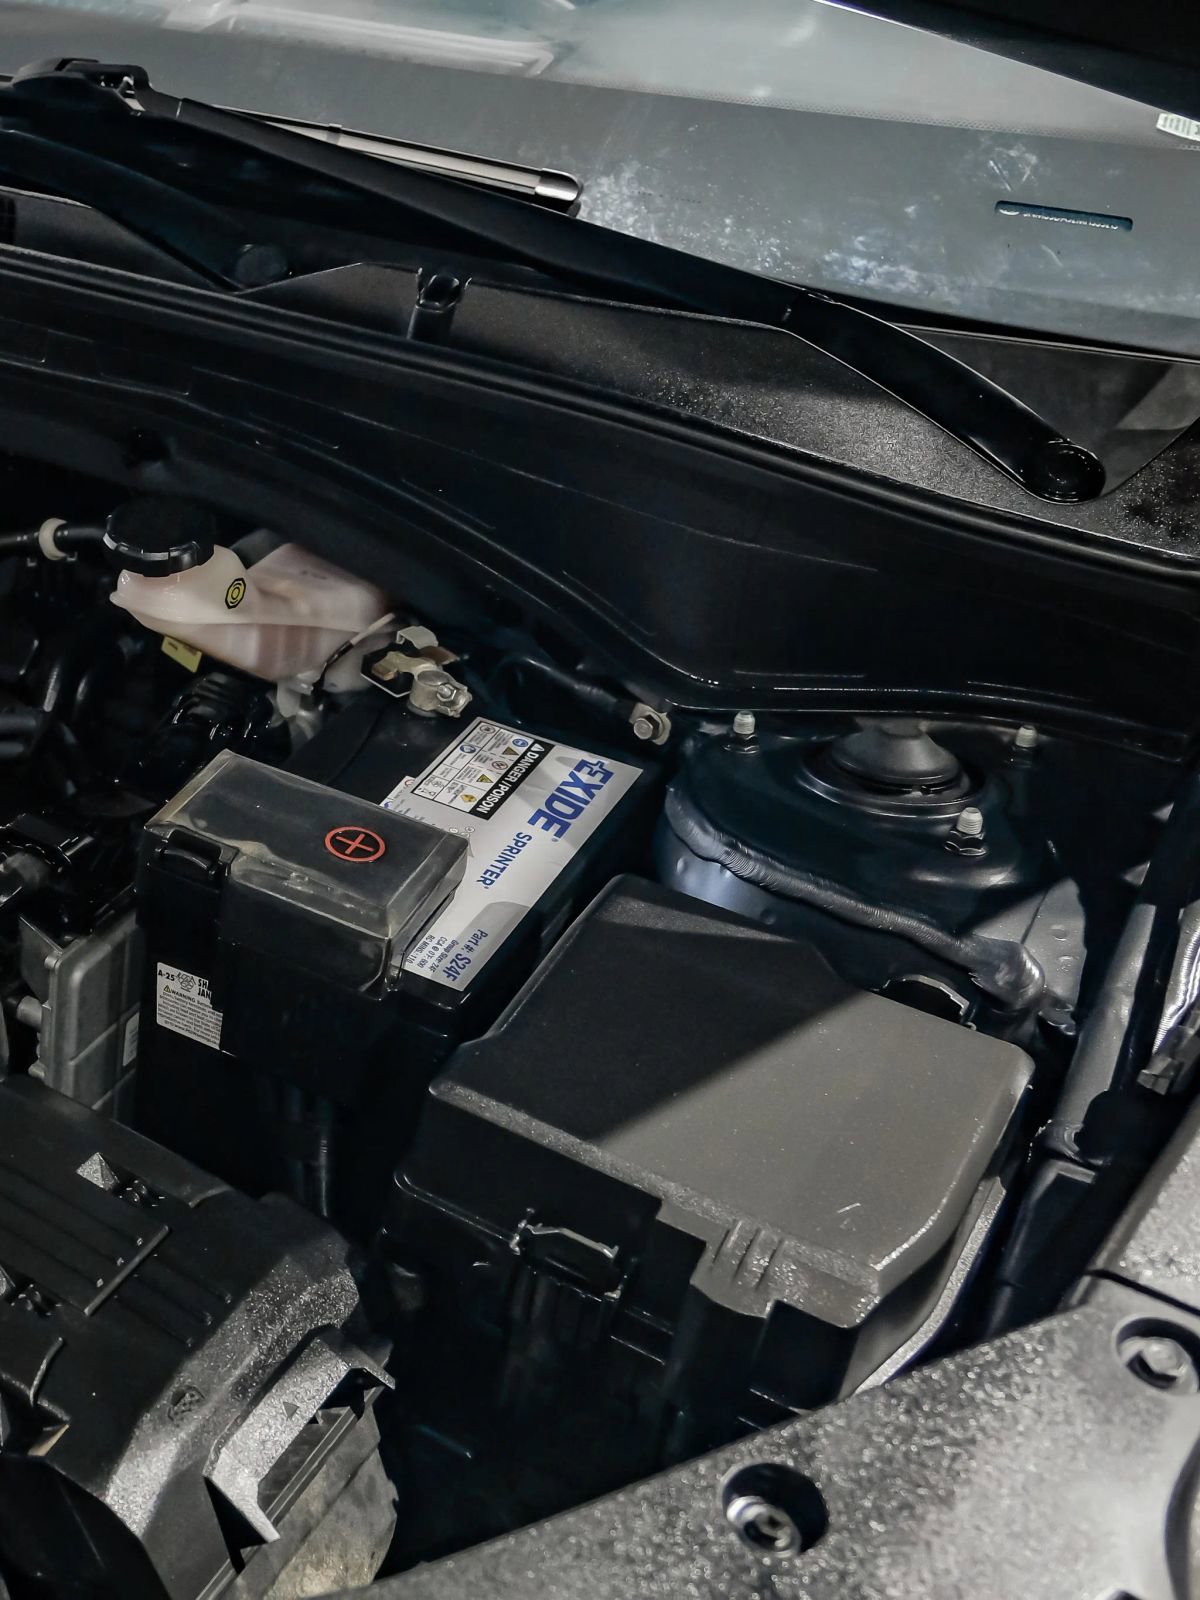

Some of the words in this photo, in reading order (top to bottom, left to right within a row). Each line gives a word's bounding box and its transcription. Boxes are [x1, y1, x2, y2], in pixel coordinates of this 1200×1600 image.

[507, 750, 539, 783] DANGER
[527, 758, 615, 839] EXIDE
[475, 831, 533, 888] SPRINTER
[435, 936, 448, 947] CCA
[470, 929, 489, 946] Part
[158, 969, 175, 981] A-25
[442, 953, 472, 982] S24F
